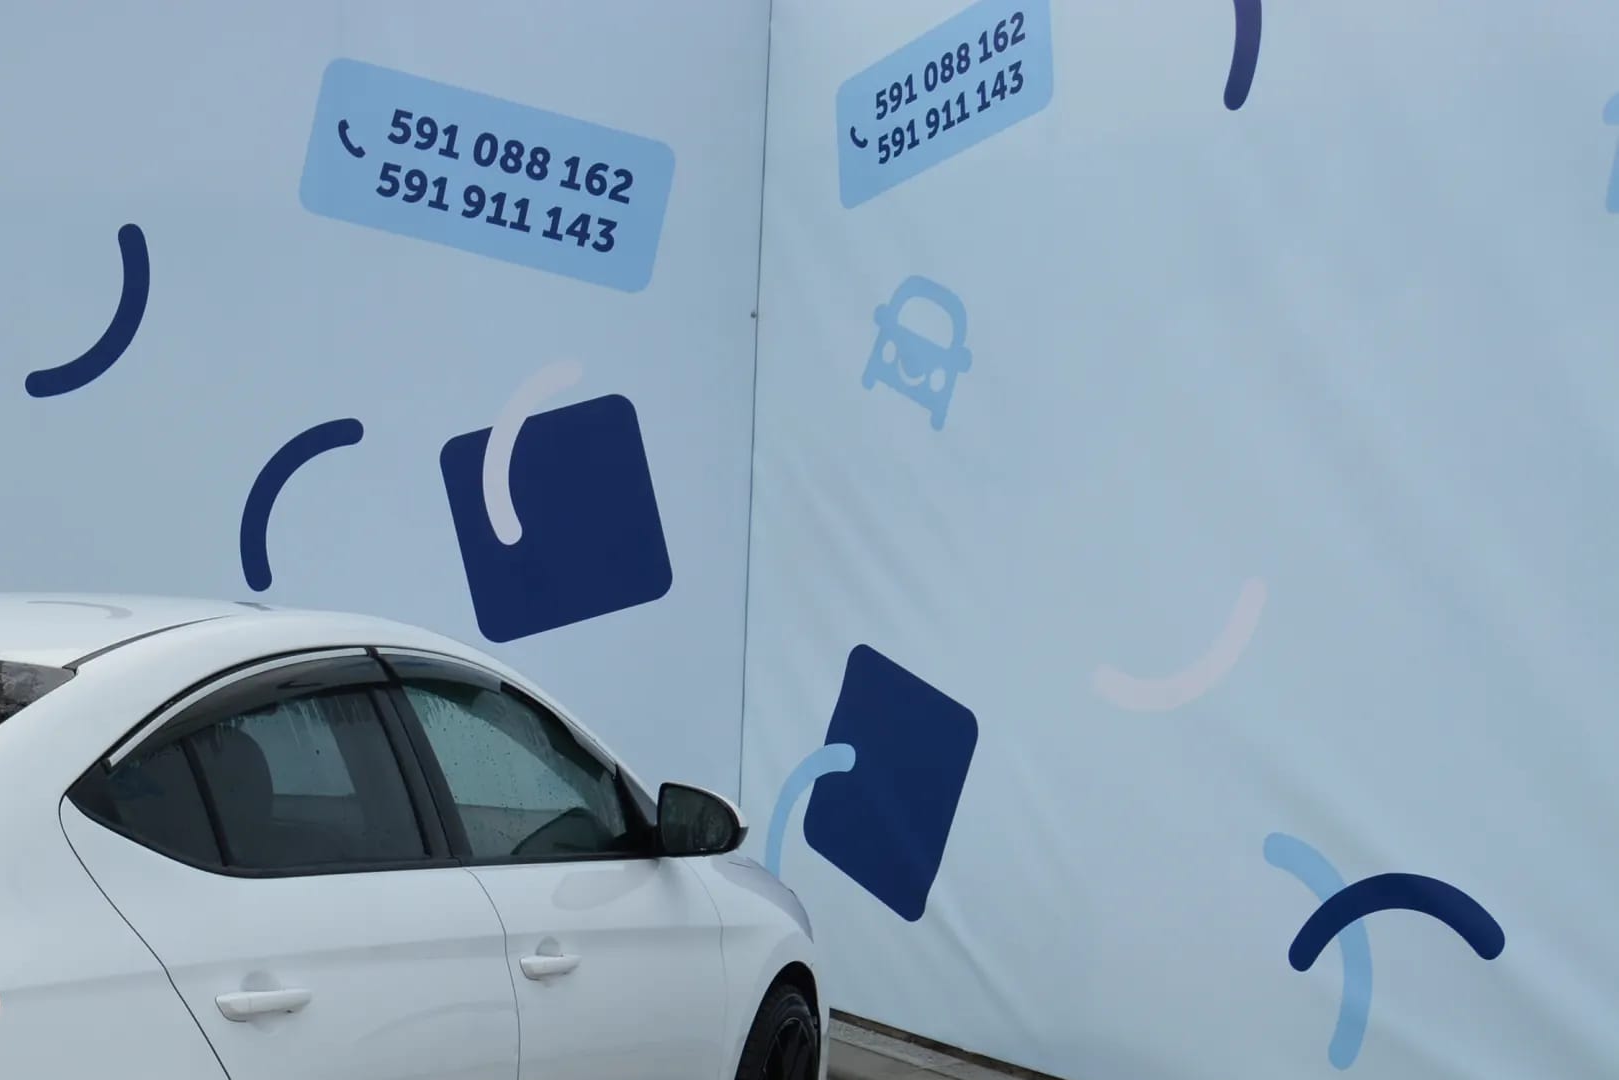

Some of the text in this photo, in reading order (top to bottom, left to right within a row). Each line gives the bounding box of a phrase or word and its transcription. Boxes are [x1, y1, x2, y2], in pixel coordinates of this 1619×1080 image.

[875, 11, 1026, 120] 591 088 162
[878, 60, 1025, 164] 591 911 143
[387, 108, 634, 204] 591 088 162
[375, 162, 618, 253] 591 911 143
